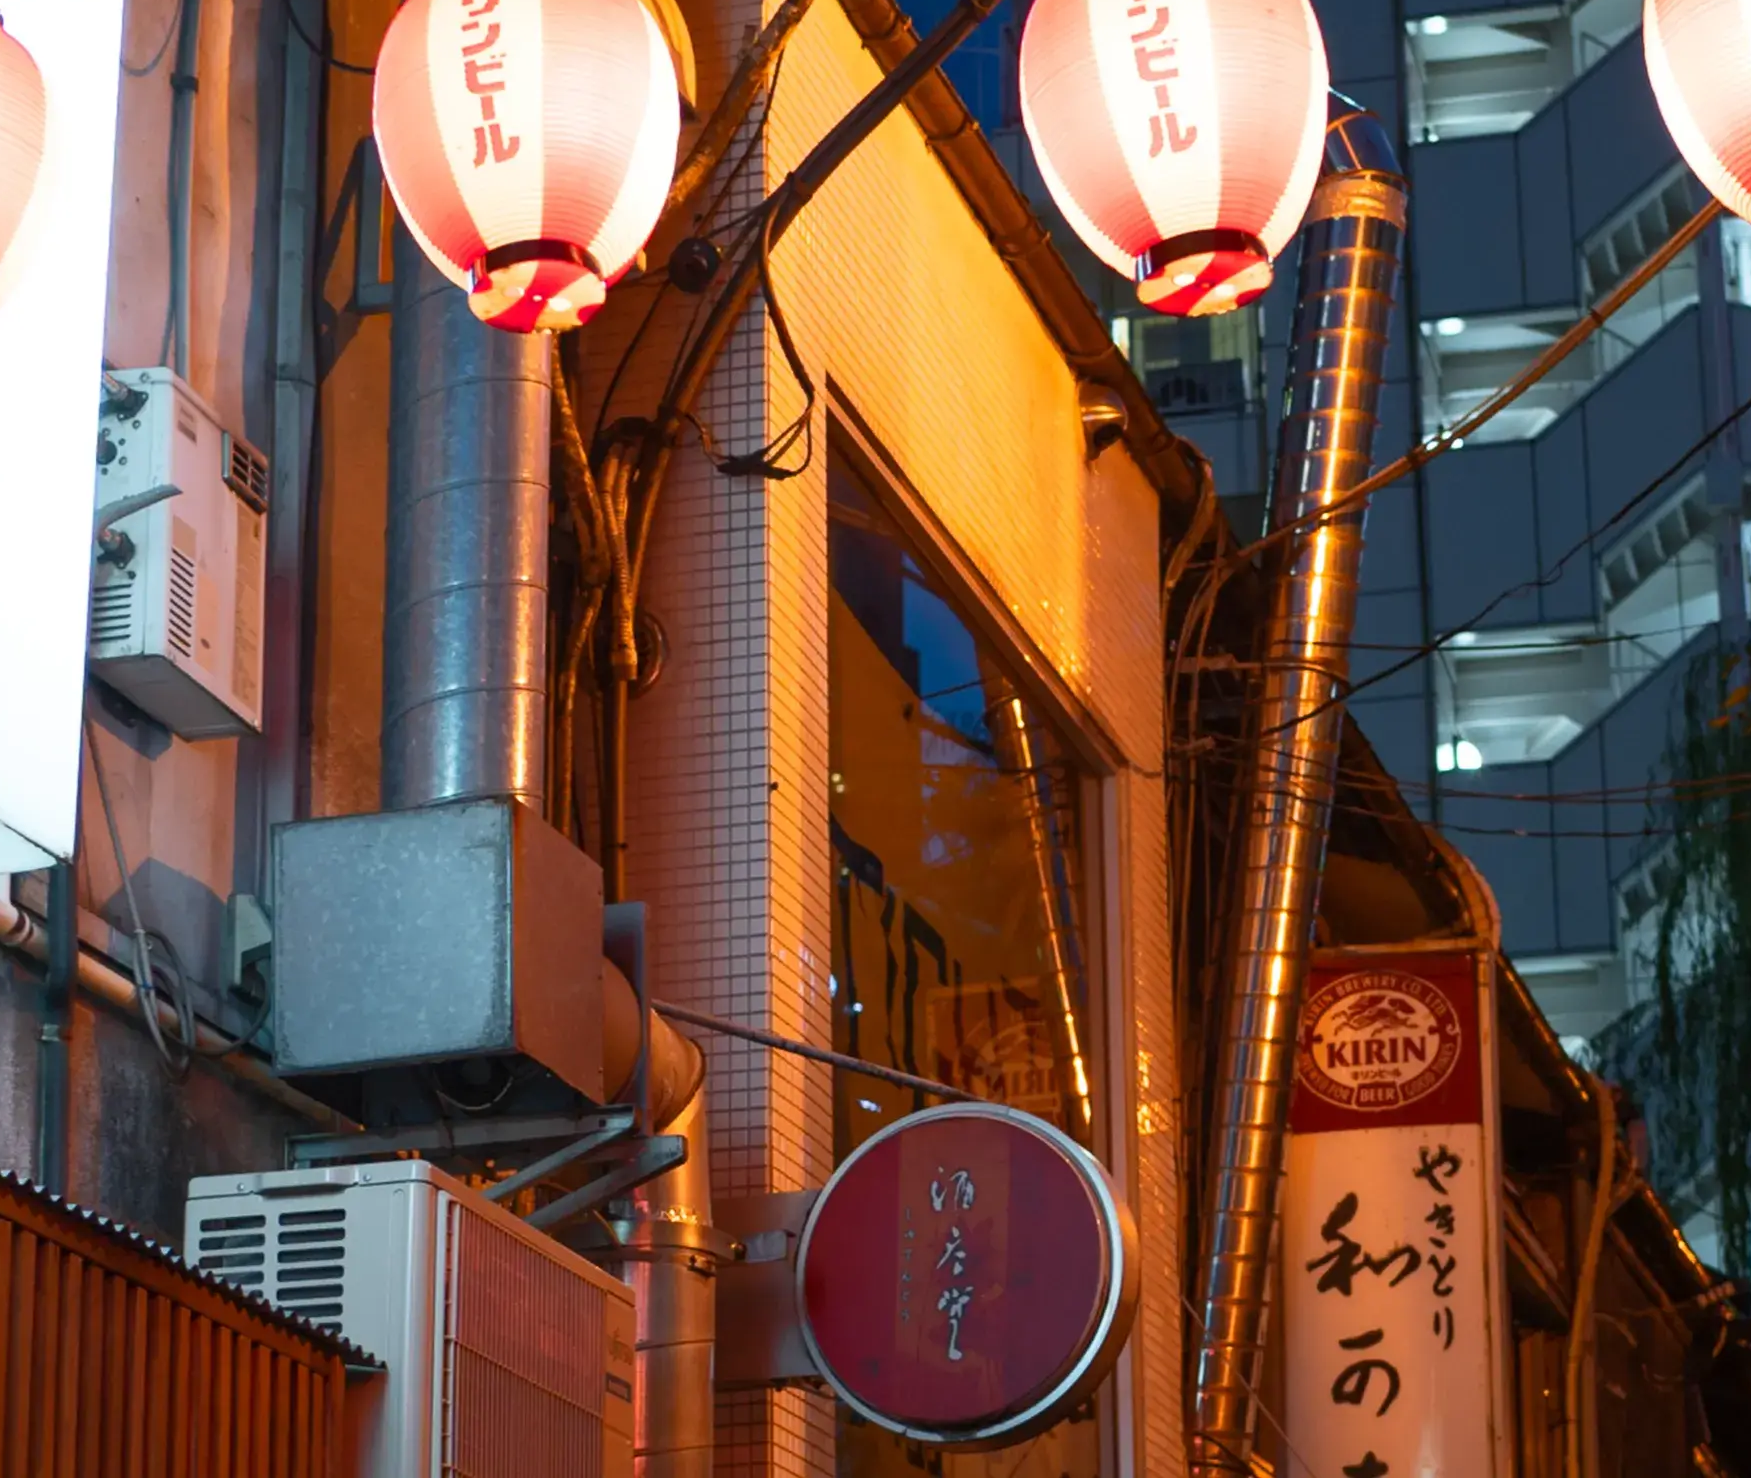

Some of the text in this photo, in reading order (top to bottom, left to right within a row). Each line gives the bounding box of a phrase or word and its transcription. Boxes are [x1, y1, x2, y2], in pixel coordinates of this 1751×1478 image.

[1326, 1036, 1427, 1069] KIRIN
[1411, 1143, 1462, 1352] やきとり
